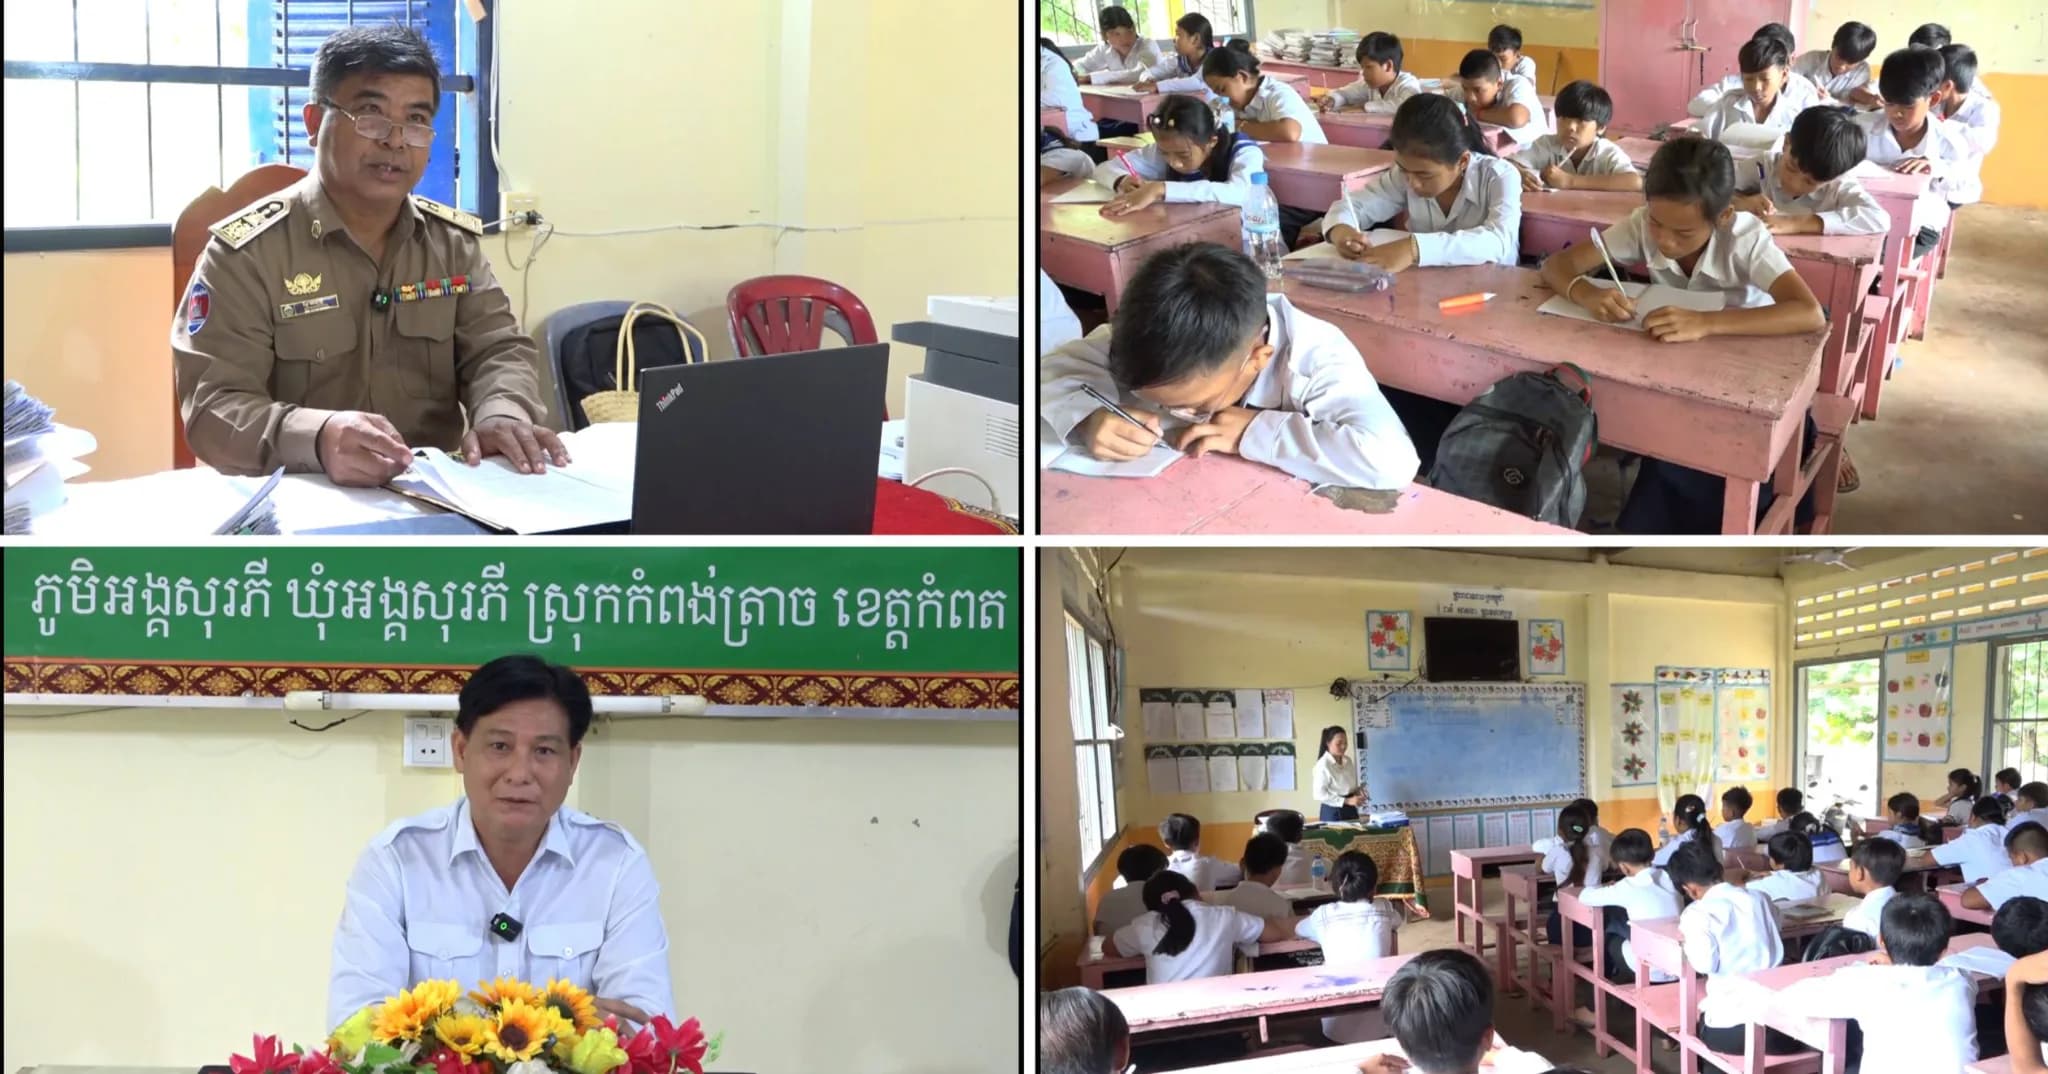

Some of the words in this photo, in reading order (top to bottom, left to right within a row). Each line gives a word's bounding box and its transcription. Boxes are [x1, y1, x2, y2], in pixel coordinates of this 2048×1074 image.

[655, 382, 684, 413] ThinkPad
[31, 557, 273, 639] ភូមិអង្គសុរភី
[286, 561, 509, 643] ឃុំអង្គសុរភី
[523, 565, 817, 652] ស្រុកកំពង់ត្រាច
[833, 572, 1007, 650] ខេត្តកំពត
